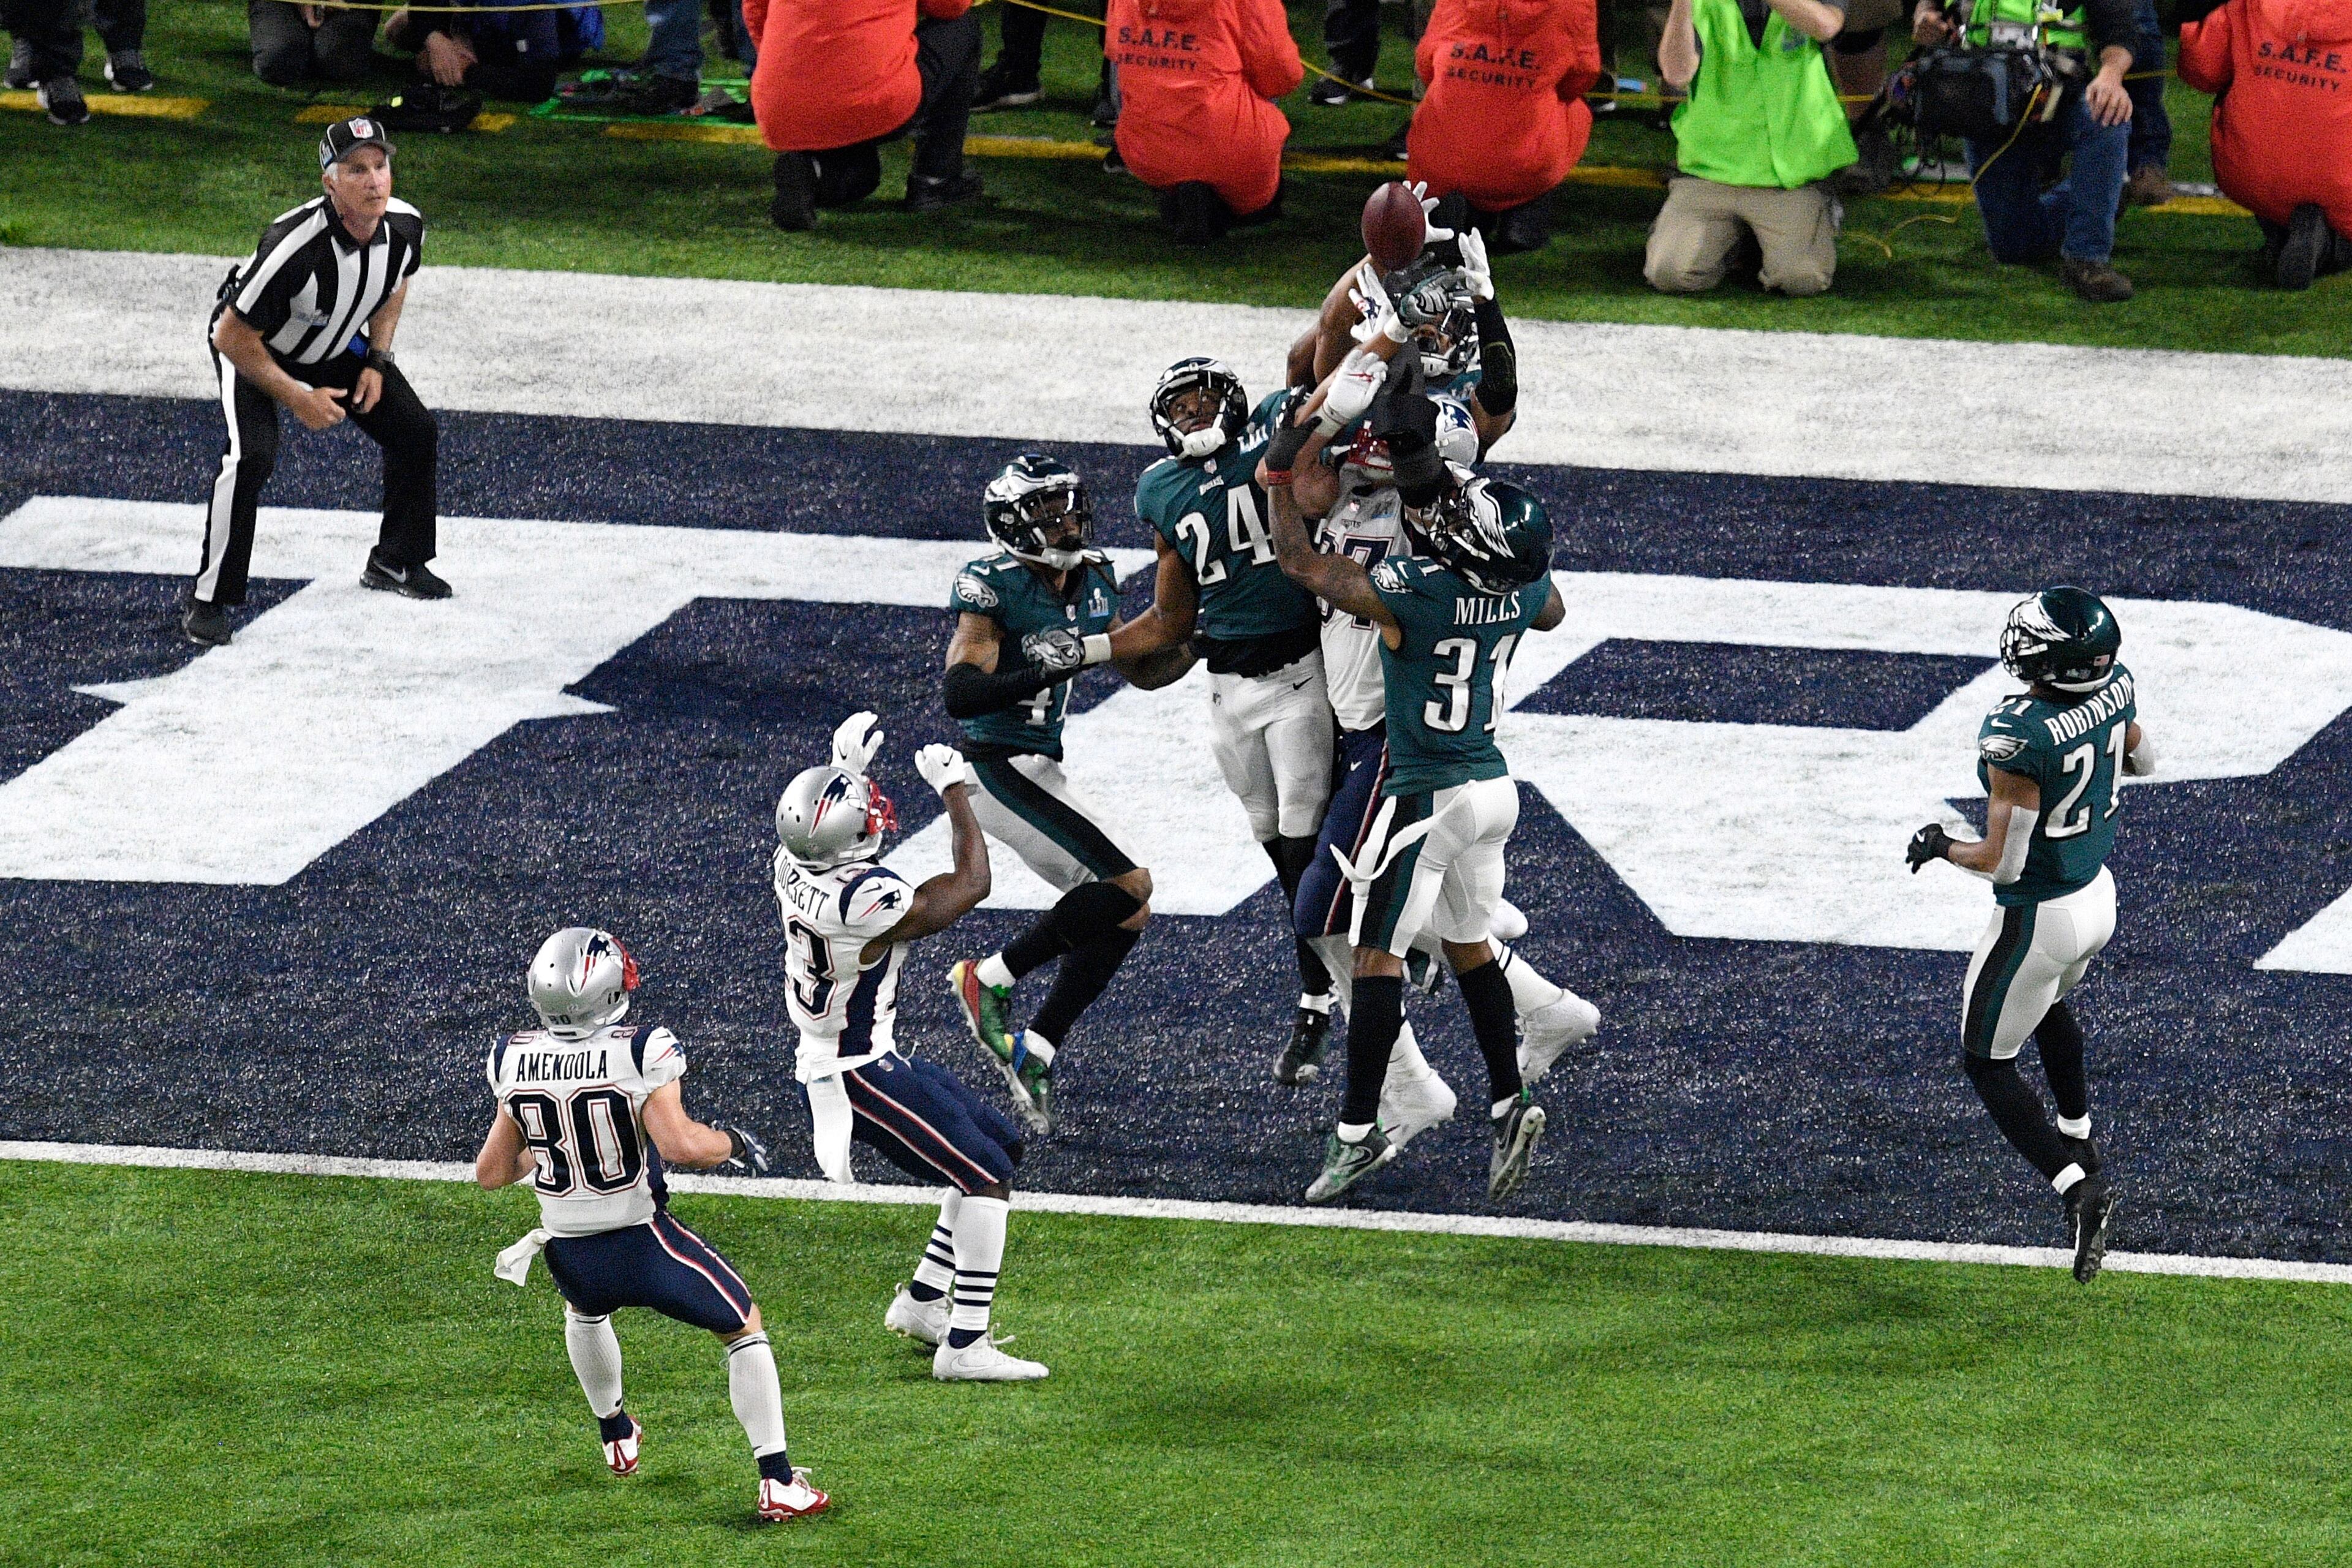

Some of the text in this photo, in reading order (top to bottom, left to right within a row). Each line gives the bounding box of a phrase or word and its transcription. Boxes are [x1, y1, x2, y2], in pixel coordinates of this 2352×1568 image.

[1118, 26, 1200, 51] S.A.F.E.
[1117, 53, 1197, 70] SECURITY
[2258, 41, 2347, 74] S.A.F.E.
[1447, 65, 1536, 89] SECURITY
[2254, 64, 2340, 92] SECURITY
[1175, 482, 1276, 586] 24
[1453, 590, 1521, 625] MILLS
[1423, 633, 1517, 732] 31
[2044, 673, 2134, 746] ROBINSON
[2045, 718, 2127, 838] 21
[515, 1049, 608, 1083] AMENDOLA
[505, 1083, 644, 1198] 80
